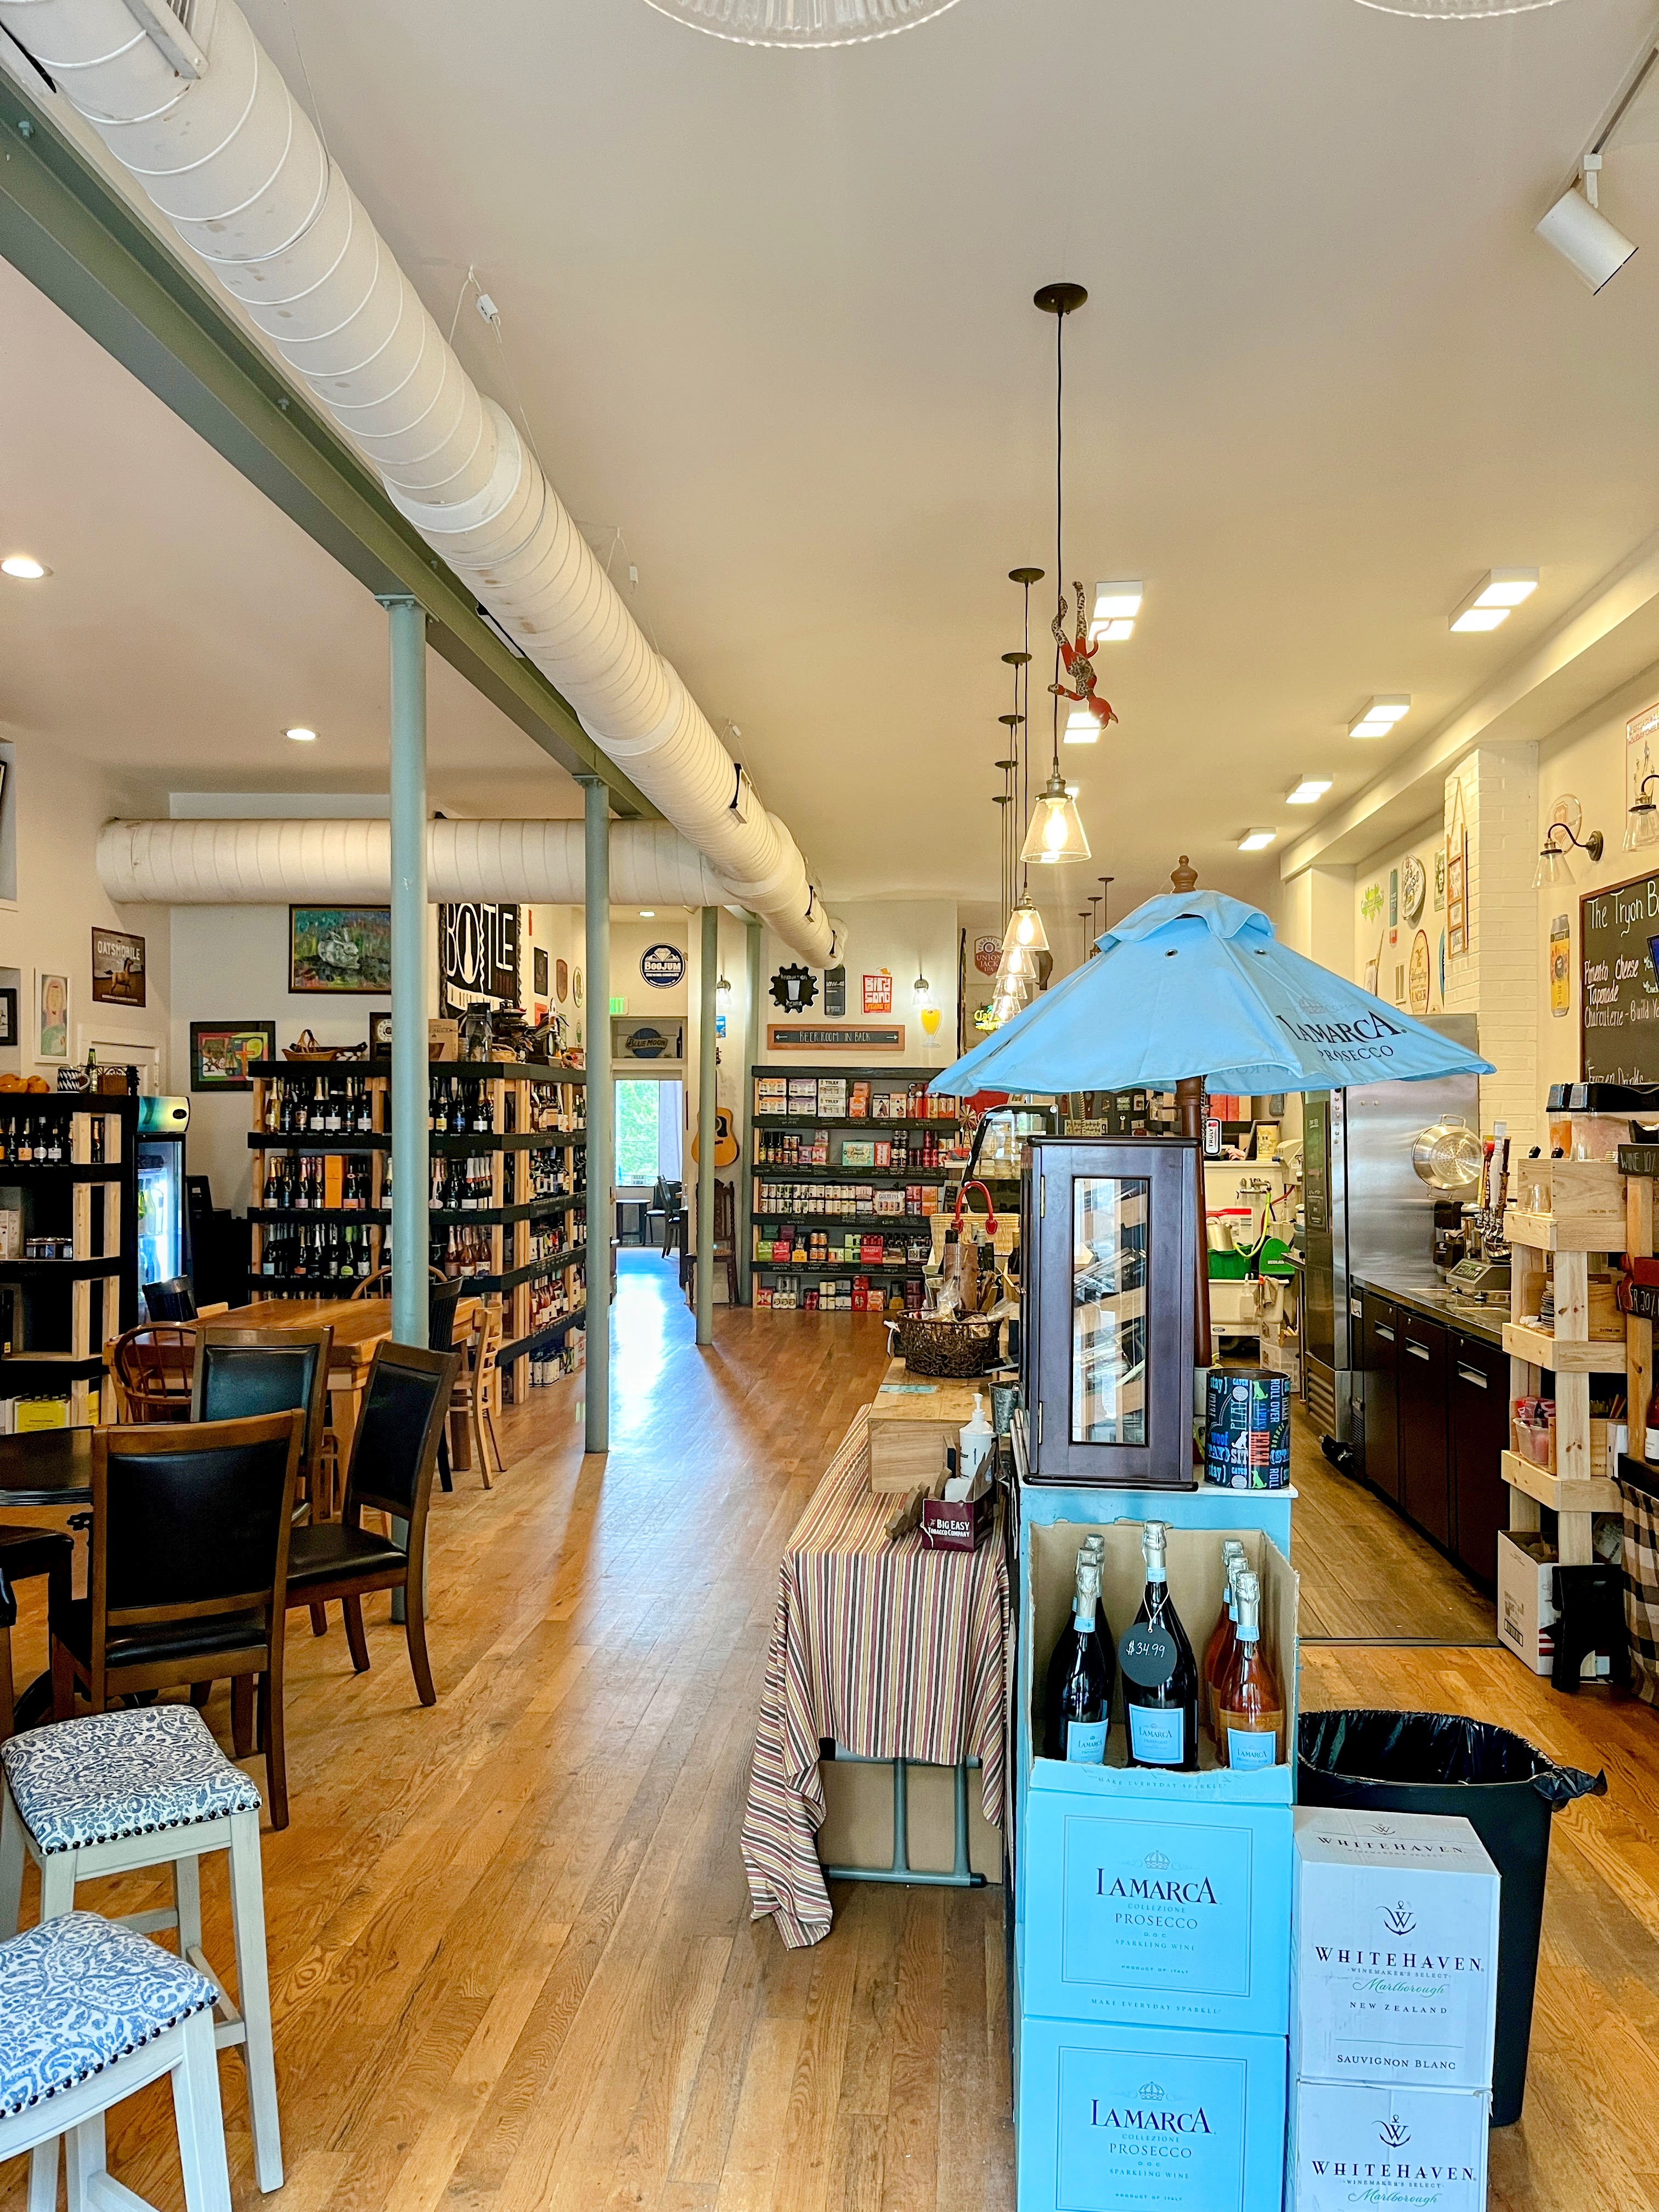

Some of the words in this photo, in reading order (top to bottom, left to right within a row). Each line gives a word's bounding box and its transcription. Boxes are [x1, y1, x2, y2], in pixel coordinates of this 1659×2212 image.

[1587, 898, 1607, 929] The
[1610, 889, 1644, 938] Tryon
[98, 941, 140, 961] OATSMOBILE
[978, 937, 1001, 951] FIRESTONE
[645, 962, 681, 970] BOOJUM
[1584, 960, 1609, 985] Pimento
[1615, 955, 1639, 980] Cheese
[1412, 989, 1427, 1003] LAGER
[1587, 979, 1618, 1010] Tapenade
[609, 997, 624, 1013] XIT
[627, 1037, 646, 1048] BLUE
[646, 1037, 666, 1046] MOON
[800, 1031, 817, 1042] BEER
[821, 1031, 839, 1042] ROOM
[844, 1032, 851, 1042] IN
[854, 1031, 871, 1042] BACK
[1318, 1045, 1394, 1062] PROSECCO
[1620, 1151, 1639, 1172] WINE
[1270, 1380, 1280, 1400] ROLL
[1231, 1399, 1248, 1431] PLAY
[1270, 1402, 1280, 1423] OVER
[1211, 1431, 1229, 1446] woof
[1231, 1449, 1249, 1465] SIT
[1269, 1468, 1279, 1489] ROLL
[927, 1527, 947, 1536] TOBACCO
[947, 1530, 970, 1538] COMPANY
[936, 1519, 950, 1530] BIG
[951, 1520, 970, 1531] EASY
[1126, 1640, 1166, 1658] $34.99
[1098, 1777, 1122, 1785] MAKE
[1317, 1836, 1464, 1854] WHITEHAVEN
[1095, 1867, 1218, 1905] LAMARCA
[1127, 1903, 1186, 1914] COLLEZIONE
[1115, 1912, 1198, 1929] PROSECCO
[1115, 1938, 1167, 1949] SPARKLING
[1314, 1946, 1482, 1972] WHITEHAVEN
[1351, 1967, 1411, 1977] WINEMAKER'S
[1352, 1977, 1450, 1998] Marlborough
[1091, 1998, 1116, 2006] MAKE
[1122, 2001, 1171, 2011] EVERYDAY
[1176, 2006, 1218, 2014] SPARKLE
[1349, 2001, 1377, 2010] NEW
[1384, 2004, 1448, 2014] ZEALAND
[1337, 2054, 1409, 2068] SAUVIGNON
[1414, 2059, 1456, 2070] BLANC
[1090, 2098, 1212, 2135] LAMARCA
[1122, 2134, 1180, 2143] COLLEZIONE
[1109, 2143, 1192, 2159] PROSECCO
[1109, 2168, 1161, 2178] SPARKLING
[1312, 2160, 1474, 2181] WHITEHAVEN
[1347, 2188, 1443, 2208] Marlborough
